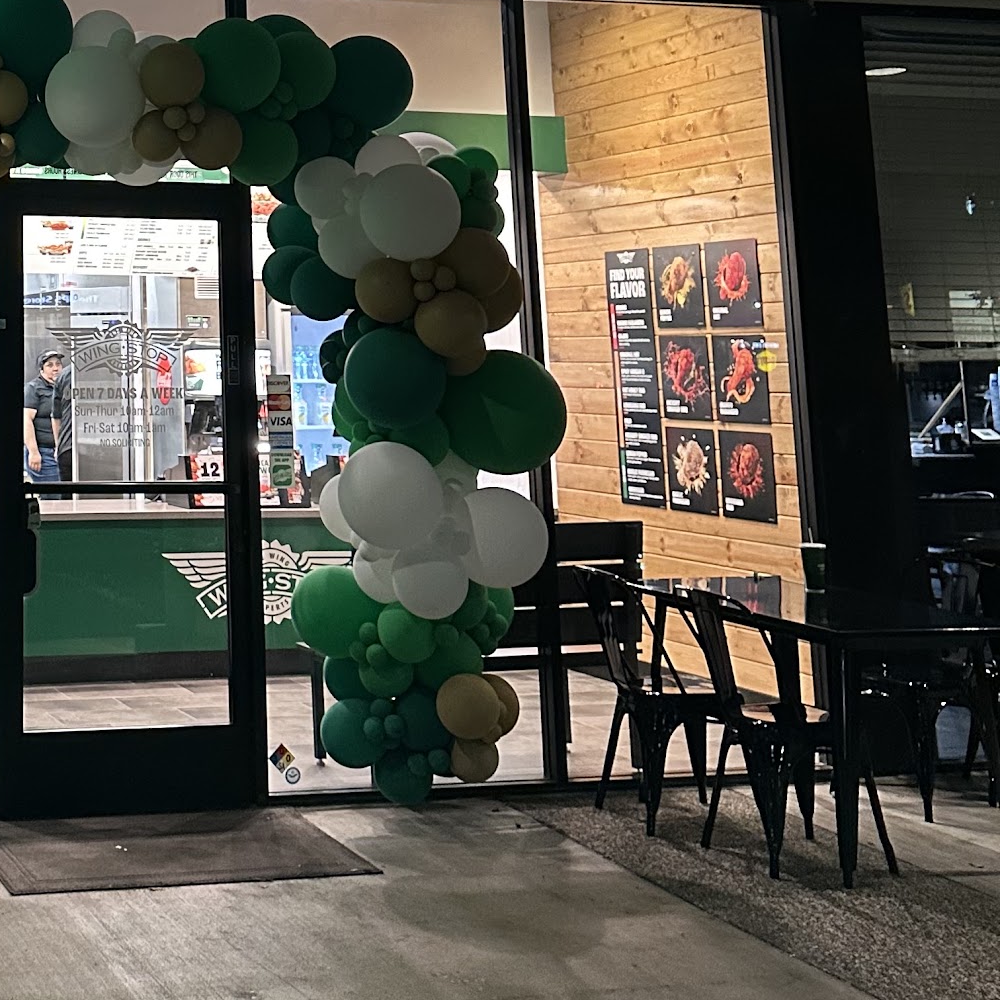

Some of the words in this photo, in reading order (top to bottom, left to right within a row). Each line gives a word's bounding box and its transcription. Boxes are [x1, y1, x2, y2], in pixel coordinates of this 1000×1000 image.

[609, 268, 625, 282] FIND
[625, 267, 645, 281] YOUR
[610, 281, 646, 299] FLAVOR
[97, 388, 105, 399] 7
[107, 388, 137, 399] DAYS
[141, 388, 148, 399] A
[151, 388, 183, 399] WEEK
[75, 405, 118, 416] Sun-Thur
[270, 416, 292, 426] VISA
[83, 422, 115, 433] Fri-Sat
[100, 438, 110, 447] NO
[201, 462, 220, 477] 12
[265, 599, 289, 611] PERTS
